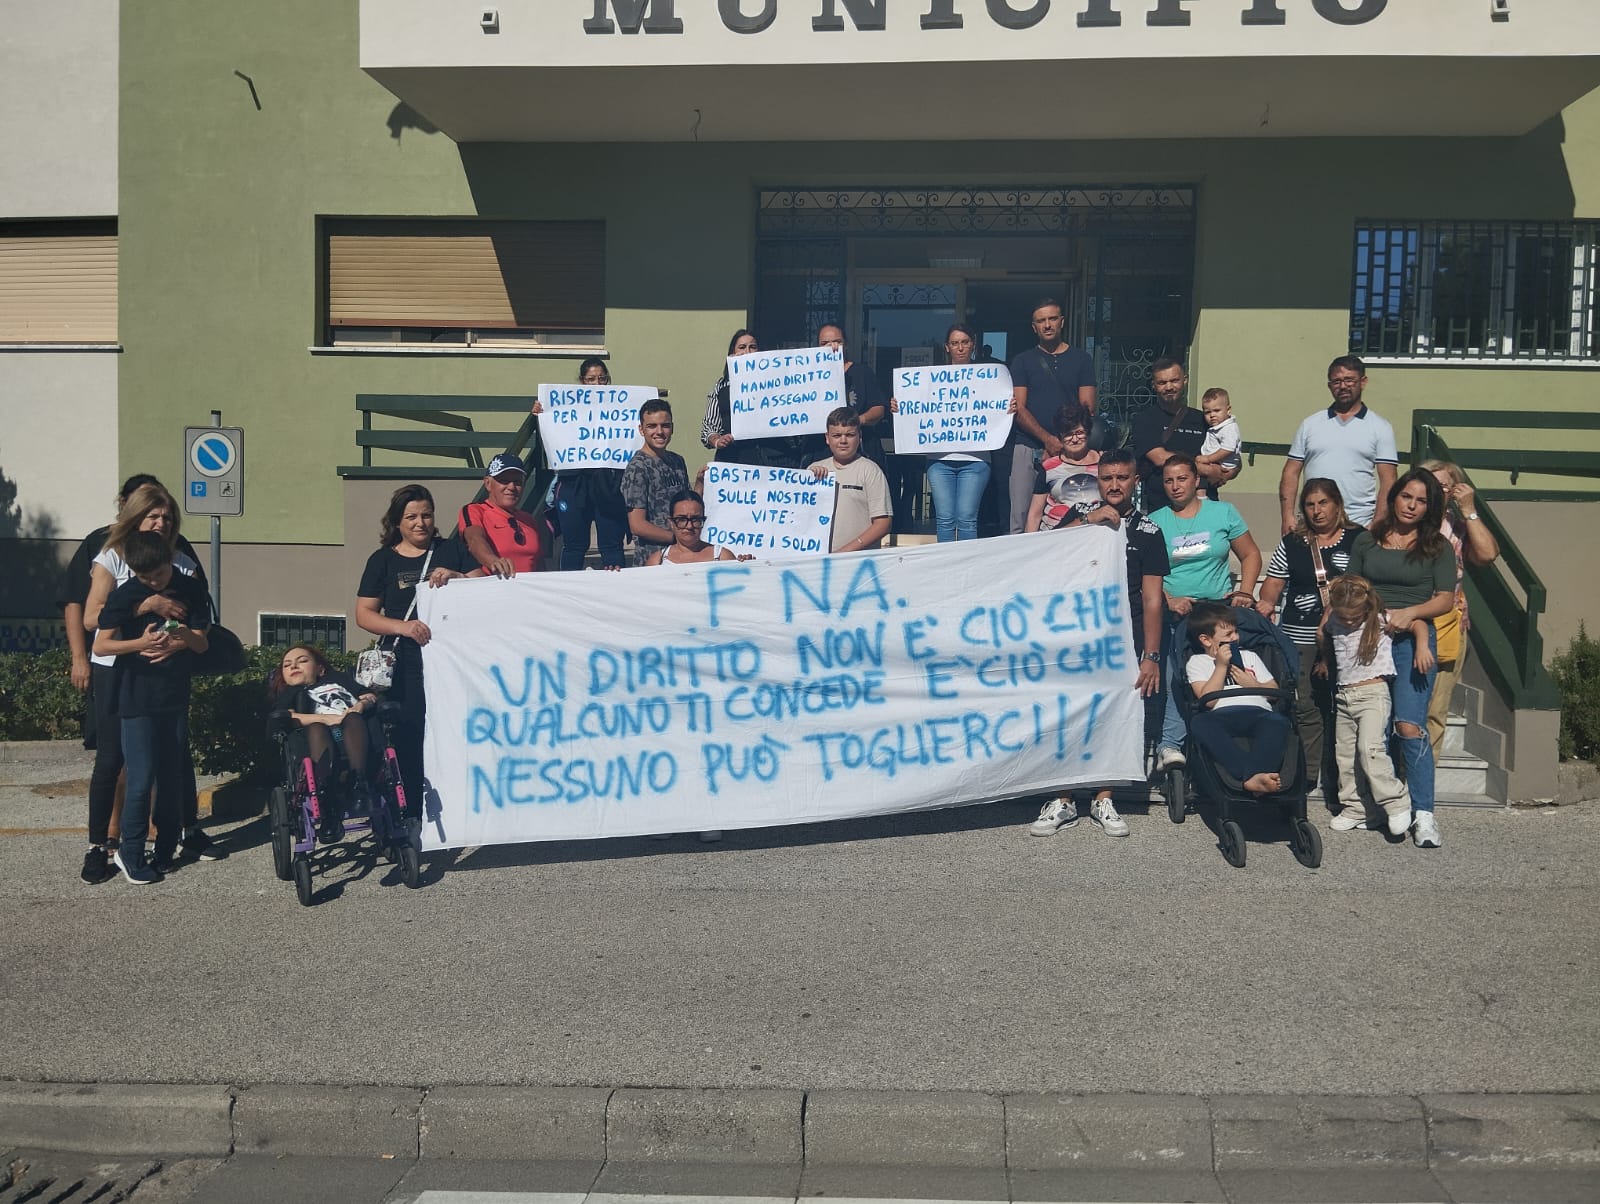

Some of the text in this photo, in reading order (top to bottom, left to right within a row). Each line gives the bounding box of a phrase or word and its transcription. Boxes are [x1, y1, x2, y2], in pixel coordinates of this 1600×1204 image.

[733, 352, 842, 375] I NOSTRI FIGLI
[740, 368, 832, 393] HANNO DIRITTO
[902, 367, 999, 388] SE VOLETE GLI
[549, 388, 628, 407] RISPETTO
[760, 391, 817, 410] ASSEGNO
[824, 390, 839, 402] DI
[553, 408, 640, 424] PER I NOST
[899, 400, 1008, 416] PRENDETEVI ANCHE
[768, 412, 809, 428] CURA
[919, 415, 987, 430] LA NOSTRA
[578, 425, 635, 442] DIRITTI
[709, 466, 761, 484] BASTA
[194, 484, 203, 496] P
[717, 487, 817, 506] SULLE NOSTRE
[707, 526, 821, 552] POSATE I SOLDI
[490, 650, 567, 707] UN
[588, 638, 763, 696] DIRITTO
[796, 620, 887, 676] NON
[1042, 583, 1123, 634] CHE
[465, 698, 673, 749] QUALCUNO
[675, 692, 712, 734] TI
[723, 670, 887, 722] CONCEDE
[1052, 632, 1127, 675] CHE
[470, 746, 679, 814] NESSUNO
